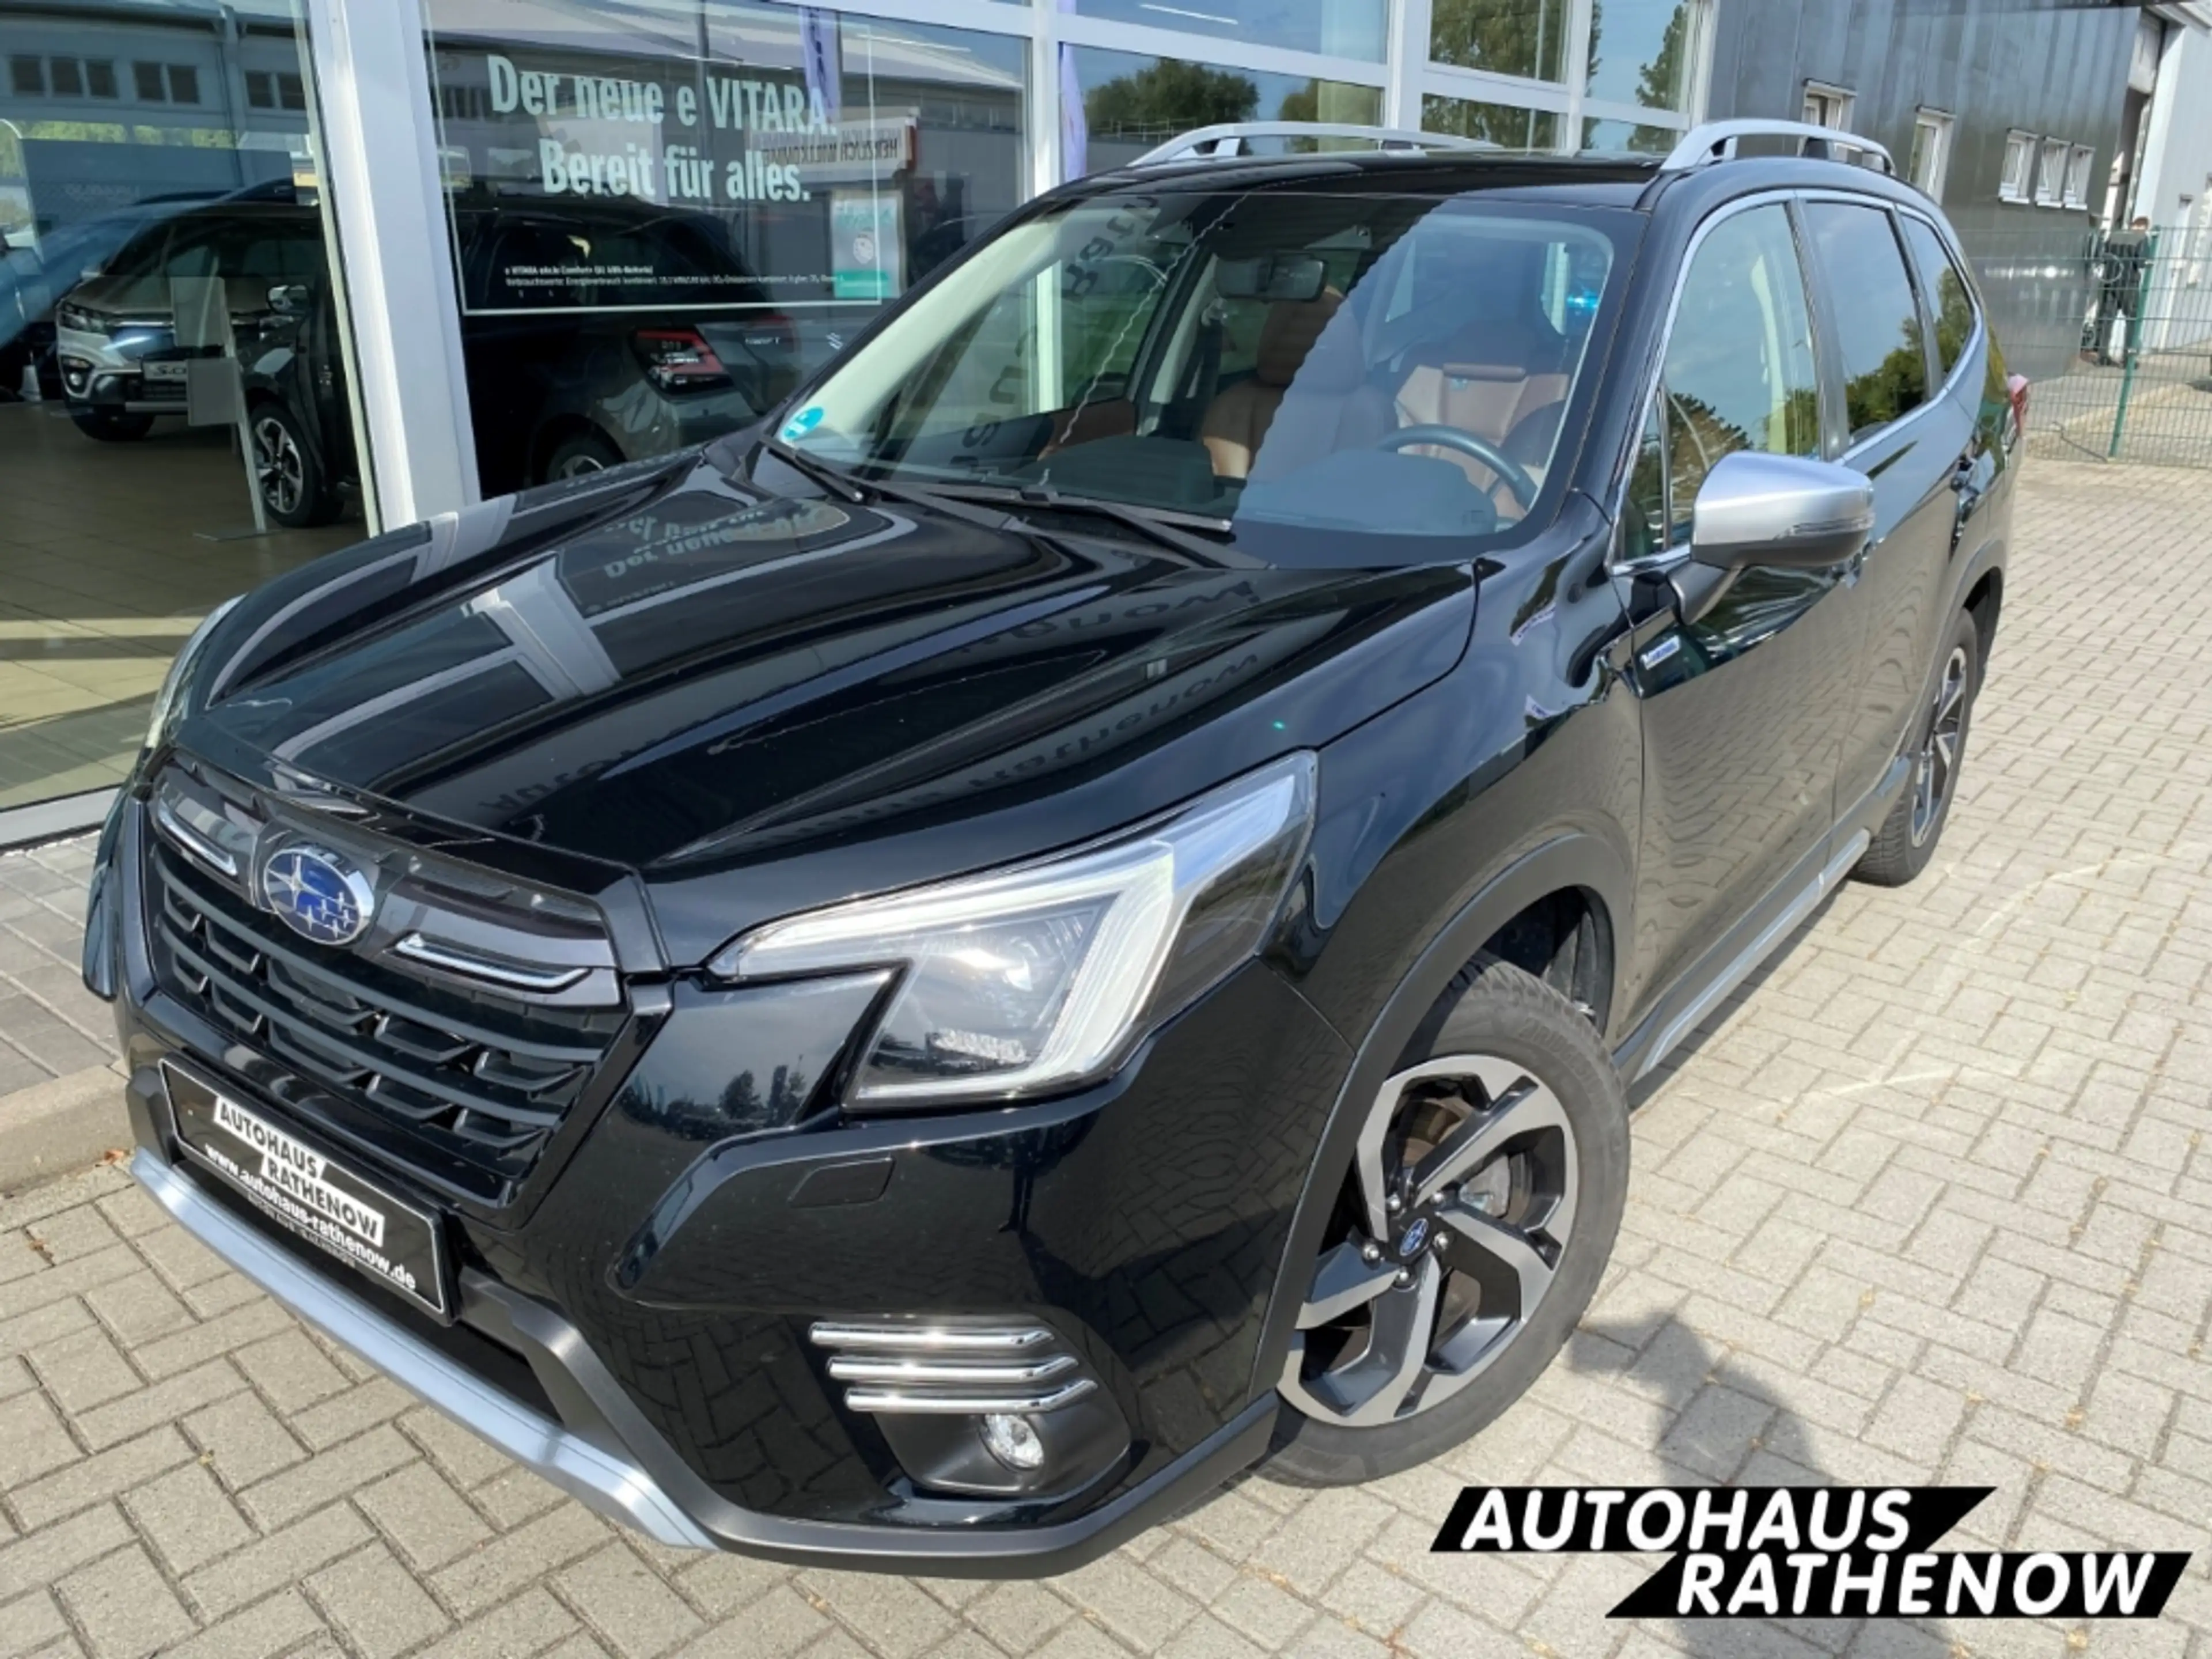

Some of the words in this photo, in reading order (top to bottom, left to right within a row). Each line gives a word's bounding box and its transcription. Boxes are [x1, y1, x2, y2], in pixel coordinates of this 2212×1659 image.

[487, 54, 560, 115] Der
[575, 75, 664, 124] neue
[677, 86, 697, 126] e
[706, 76, 836, 135] VITARA.
[539, 138, 656, 198] Bereit
[664, 145, 714, 198] für
[726, 149, 811, 202] alles.
[220, 1101, 317, 1178] AUTOHAUS
[204, 1143, 417, 1291] www.autohaus-rathenow.de
[267, 1160, 380, 1241] RATHENOW
